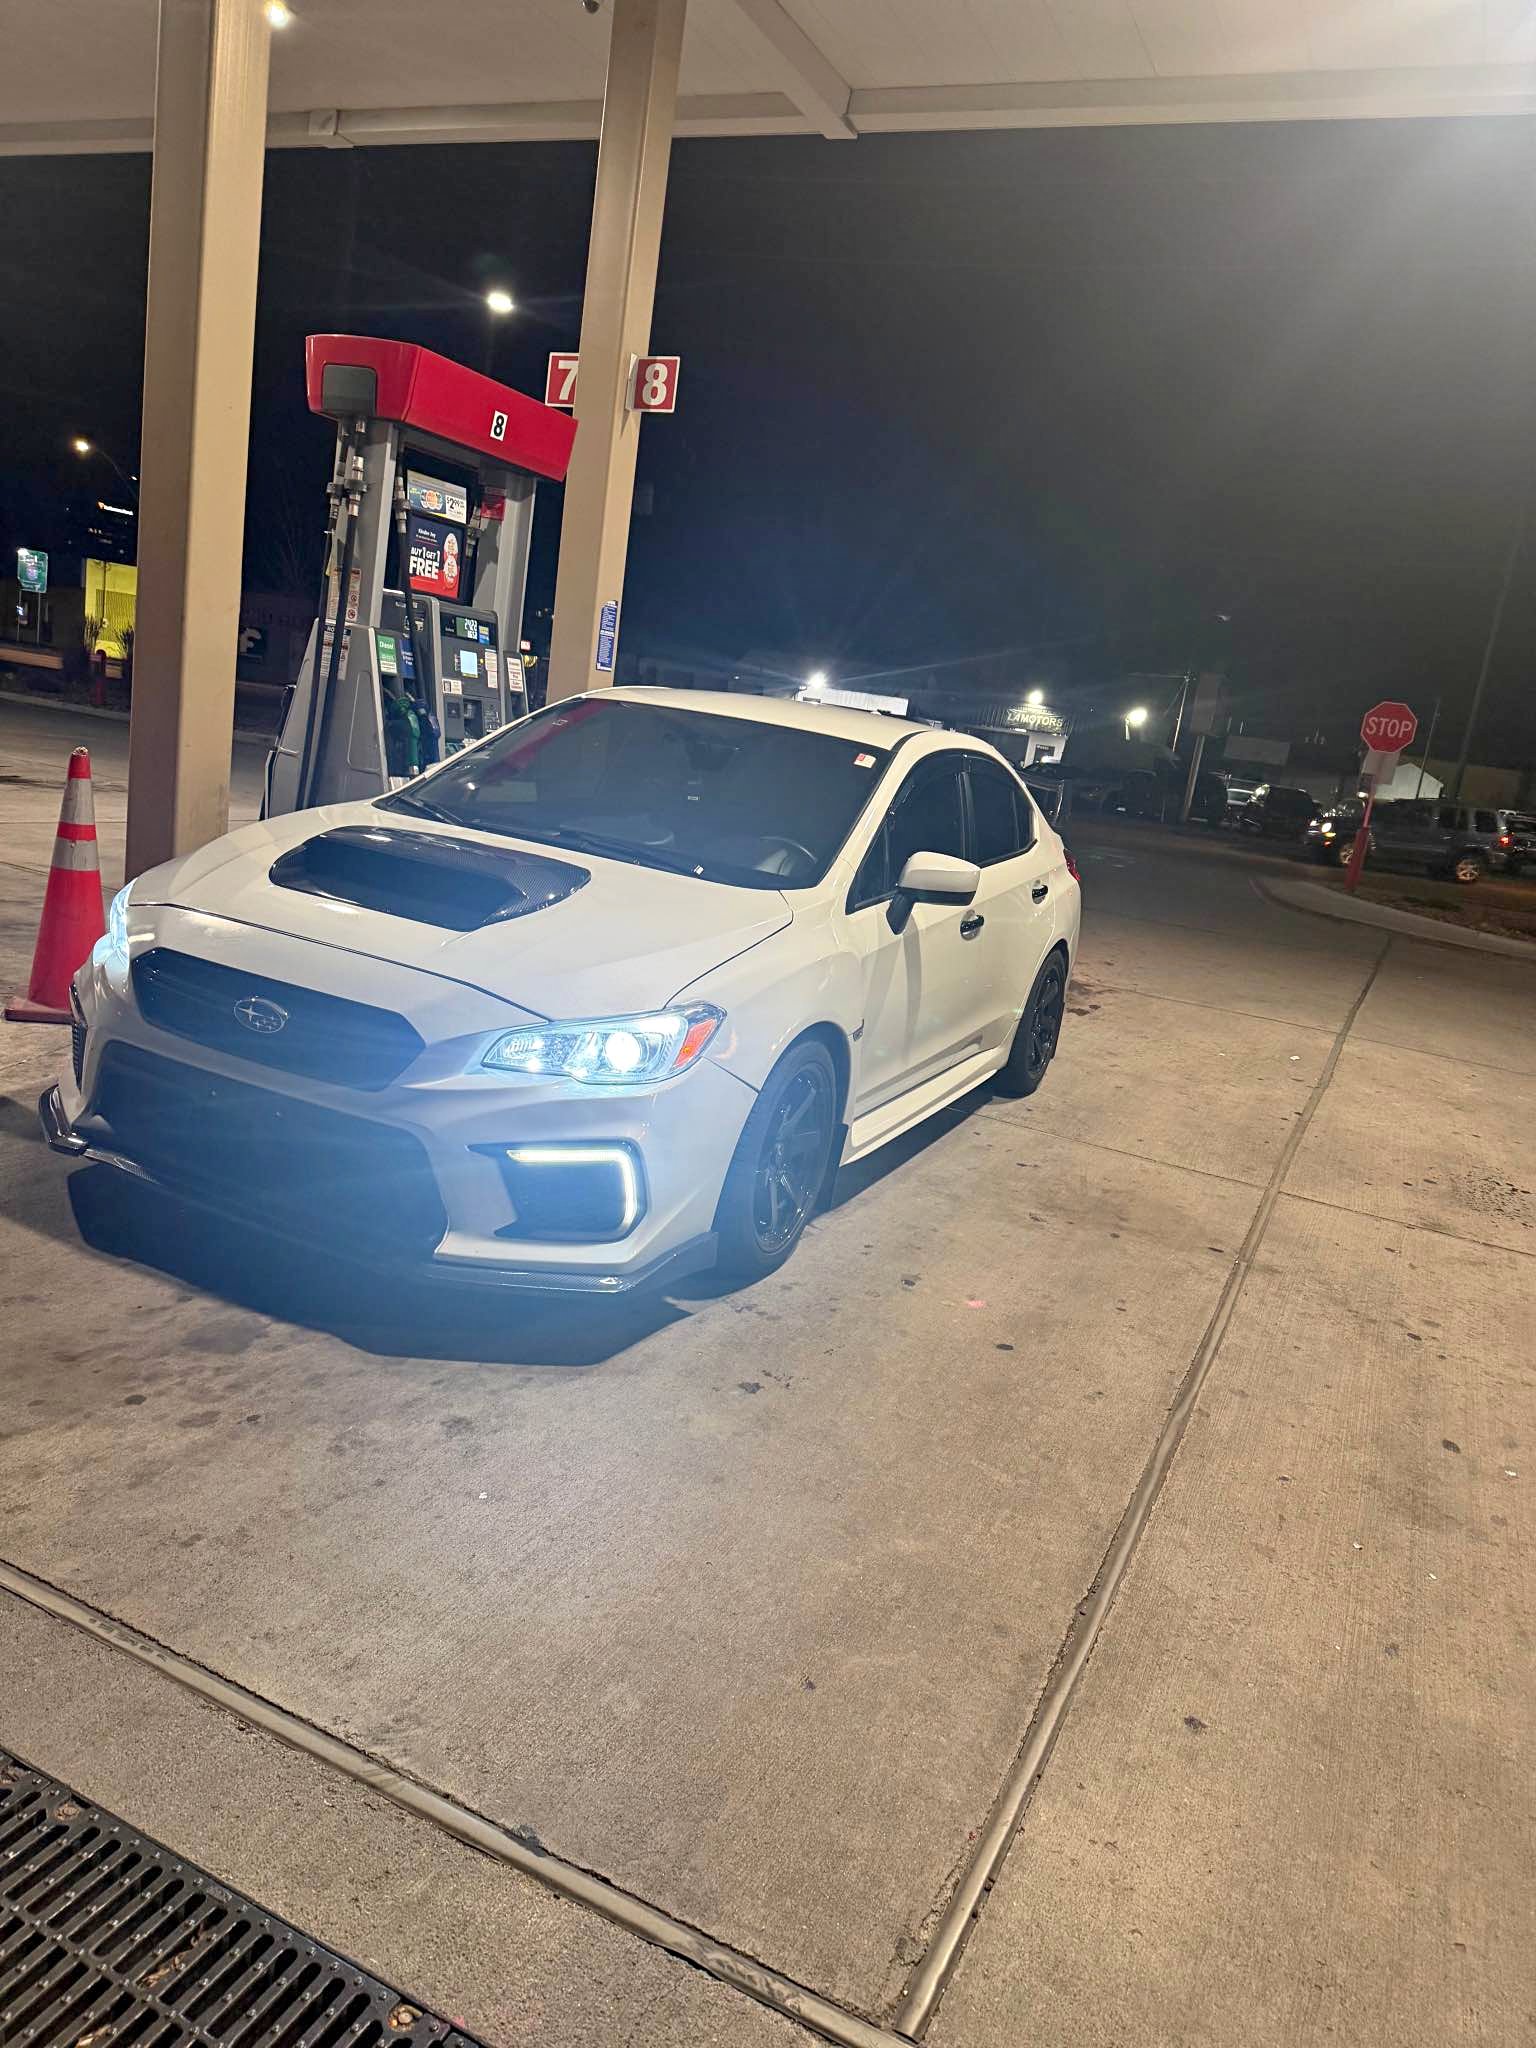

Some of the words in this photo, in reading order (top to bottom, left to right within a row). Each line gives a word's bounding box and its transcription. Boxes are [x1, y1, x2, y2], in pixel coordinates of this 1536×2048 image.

[558, 360, 579, 400] 7
[642, 363, 668, 406] 8
[493, 414, 505, 437] 8
[410, 546, 423, 557] BUY
[422, 546, 427, 559] 1
[426, 550, 436, 560] GET
[437, 550, 441, 562] 1
[409, 555, 440, 580] FREE
[1365, 716, 1413, 738] STOP
